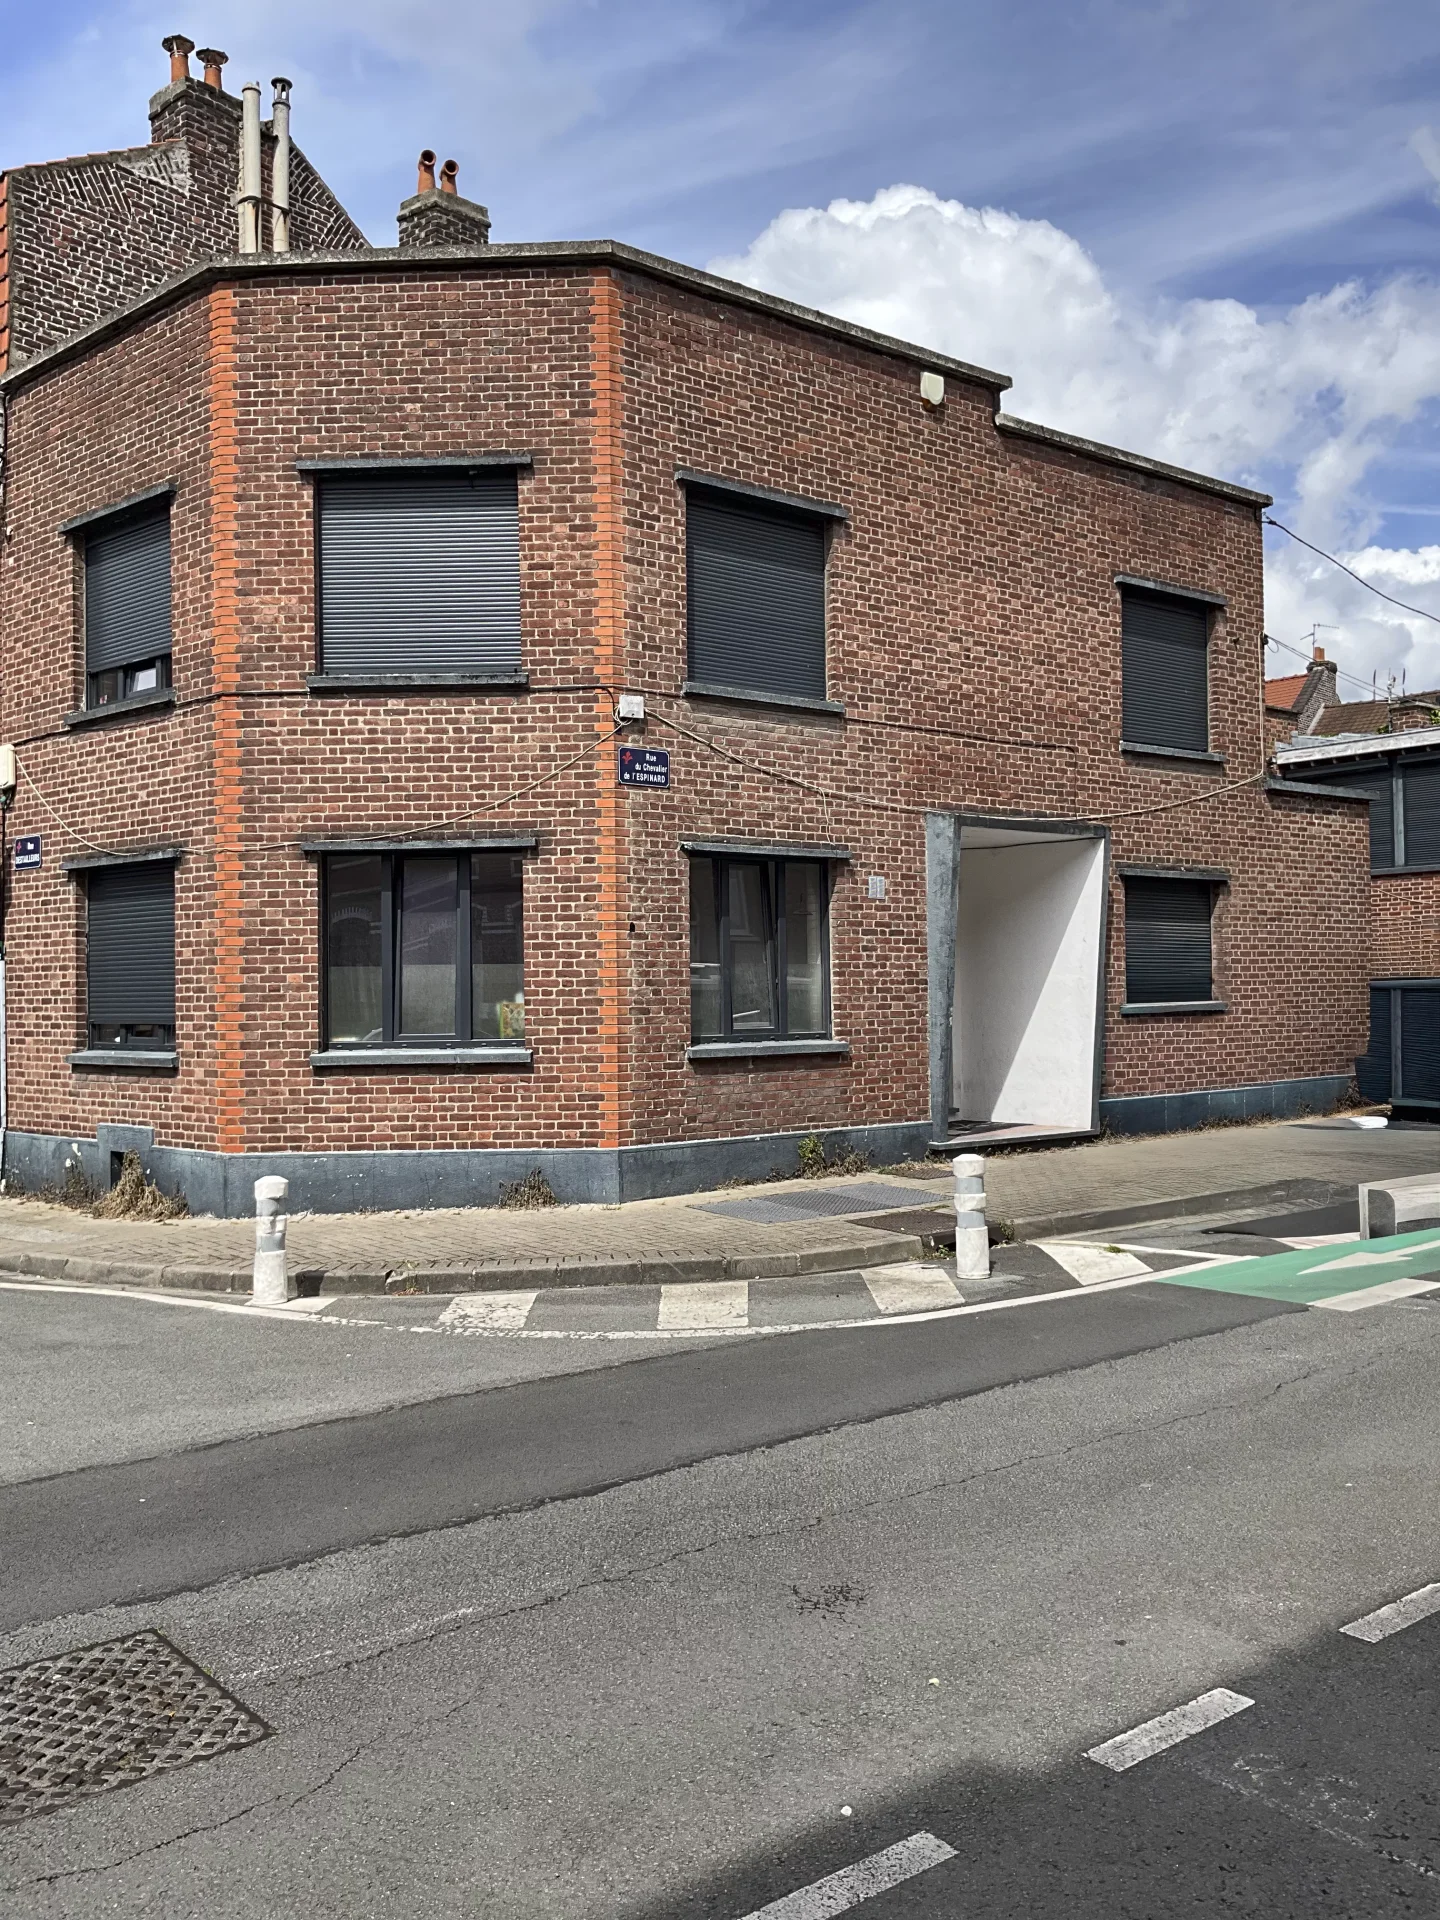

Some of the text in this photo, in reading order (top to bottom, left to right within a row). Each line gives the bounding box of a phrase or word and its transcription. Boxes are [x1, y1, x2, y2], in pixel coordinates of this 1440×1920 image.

[646, 753, 656, 762] Rue
[635, 762, 667, 772] du Chevalier
[623, 772, 666, 783] de l'ESPINARD
